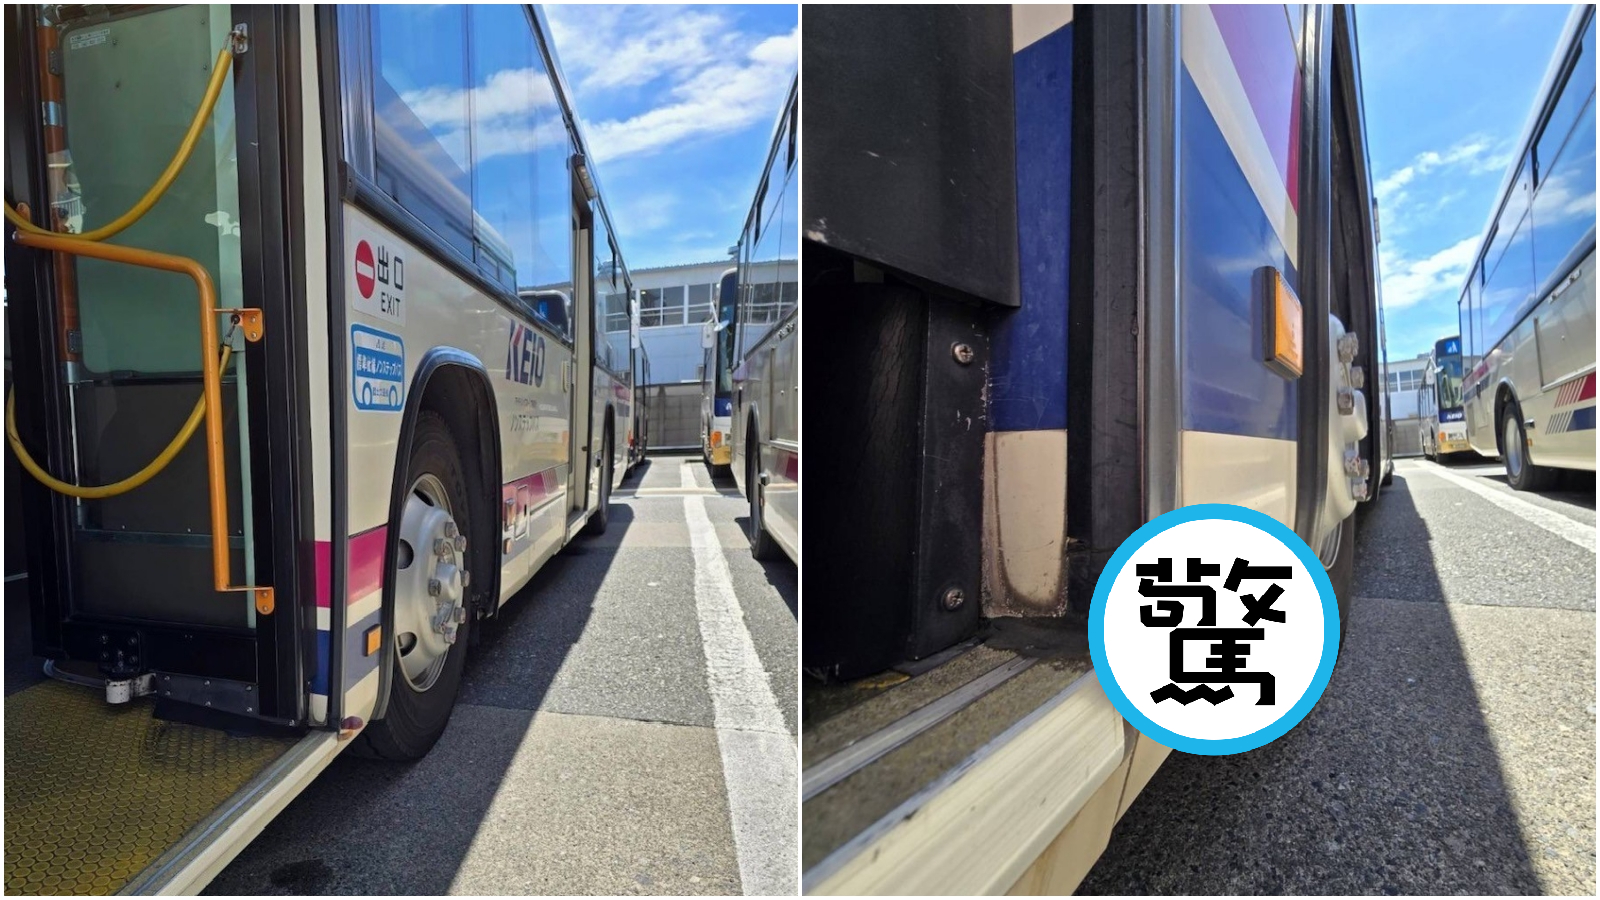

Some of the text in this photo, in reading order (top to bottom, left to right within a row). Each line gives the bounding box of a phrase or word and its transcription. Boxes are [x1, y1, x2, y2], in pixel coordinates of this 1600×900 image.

[377, 244, 404, 291] 出口
[380, 291, 401, 317] EXIT
[505, 319, 546, 388] KEIO
